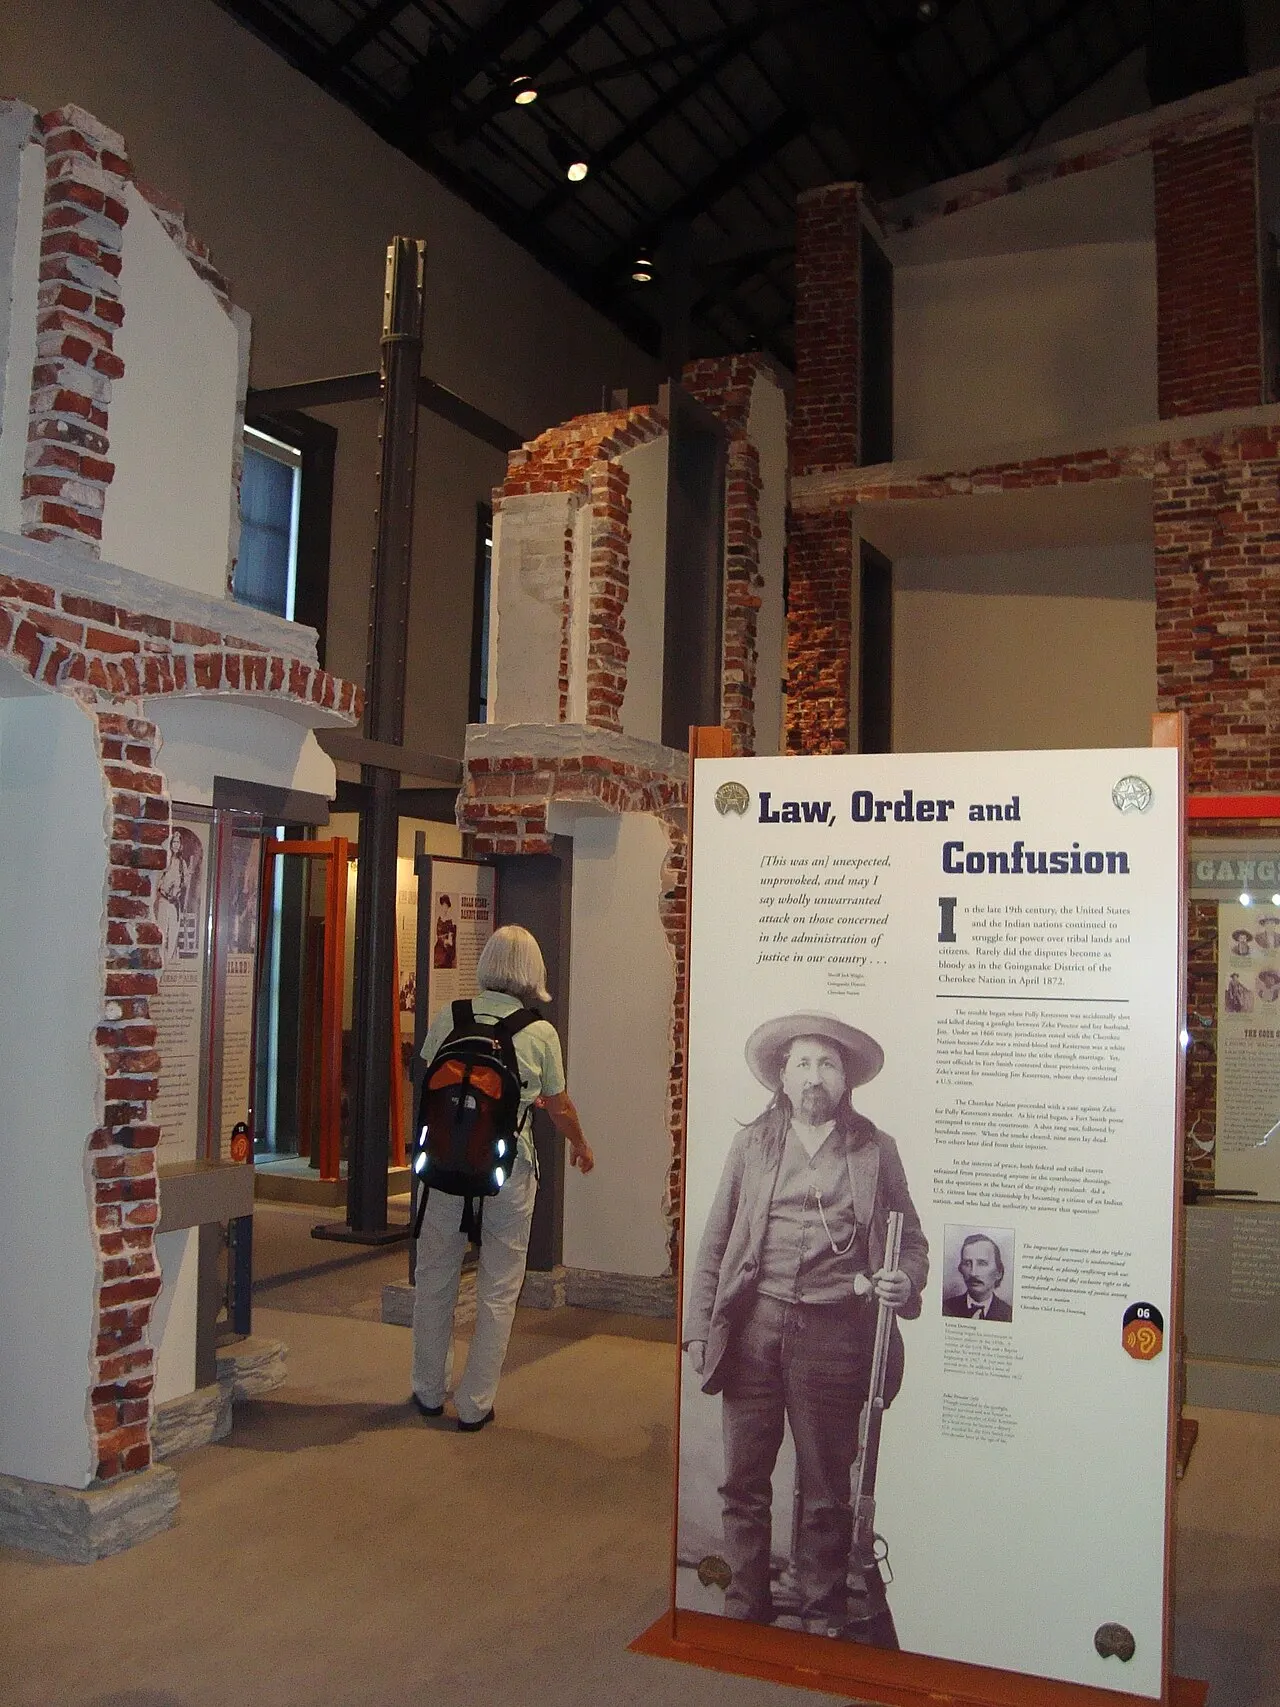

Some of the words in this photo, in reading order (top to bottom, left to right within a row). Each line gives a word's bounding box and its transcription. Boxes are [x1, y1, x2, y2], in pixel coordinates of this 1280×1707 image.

[758, 791, 837, 827] Law,
[851, 789, 955, 823] Order
[968, 795, 1021, 822] and
[760, 855, 786, 870] [This
[790, 858, 808, 866] was
[811, 855, 829, 870] an]
[832, 855, 890, 870] unexpected,
[942, 841, 1130, 875] Confusion
[1197, 860, 1280, 881] GANG
[760, 874, 820, 889] unprovoked,
[824, 874, 844, 885] and
[848, 877, 869, 889] may
[873, 874, 877, 885] I
[760, 896, 774, 908] say
[778, 893, 810, 908] wholly
[814, 893, 881, 904] unwarranted
[972, 905, 985, 914] the
[986, 905, 1001, 914] late
[1004, 905, 1023, 914] 19th
[1059, 905, 1073, 914] the
[1075, 906, 1104, 914] United
[1106, 906, 1130, 914] States
[758, 912, 790, 924] attack
[792, 916, 805, 924] on
[808, 913, 834, 924] those
[837, 913, 888, 925] concerned
[971, 918, 986, 927] and
[988, 919, 1001, 927] the
[1004, 919, 1030, 928] Indian
[1033, 919, 1063, 928] nations
[1064, 920, 1106, 928] continued
[1108, 920, 1117, 928] to
[759, 931, 769, 943] in
[772, 932, 788, 943] the
[790, 932, 866, 944] administration
[870, 932, 884, 947] of
[971, 933, 1003, 944] struggle
[1004, 933, 1017, 942] for
[1019, 936, 1044, 945] power
[1066, 934, 1088, 943] tribal
[1090, 934, 1112, 943] lands
[1114, 934, 1130, 943] and
[757, 950, 789, 966] justice
[793, 951, 803, 963] in
[806, 955, 824, 963] our
[827, 952, 866, 967] country
[975, 948, 1001, 959] Rarely
[1002, 948, 1016, 956] did
[1018, 948, 1032, 957] the
[1033, 948, 1067, 960] disputes
[1069, 949, 1101, 958] become
[938, 961, 966, 972] bloody
[978, 961, 986, 970] in
[988, 962, 1001, 970] the
[1003, 962, 1051, 974] Goingsnake
[1054, 963, 1084, 972] District
[1087, 963, 1096, 972] of
[1098, 964, 1111, 972] the
[938, 975, 975, 984] Cherokee
[978, 976, 1006, 984] Nation
[1008, 976, 1017, 985] in
[1018, 976, 1039, 988] April
[1137, 1308, 1150, 1319] 06
